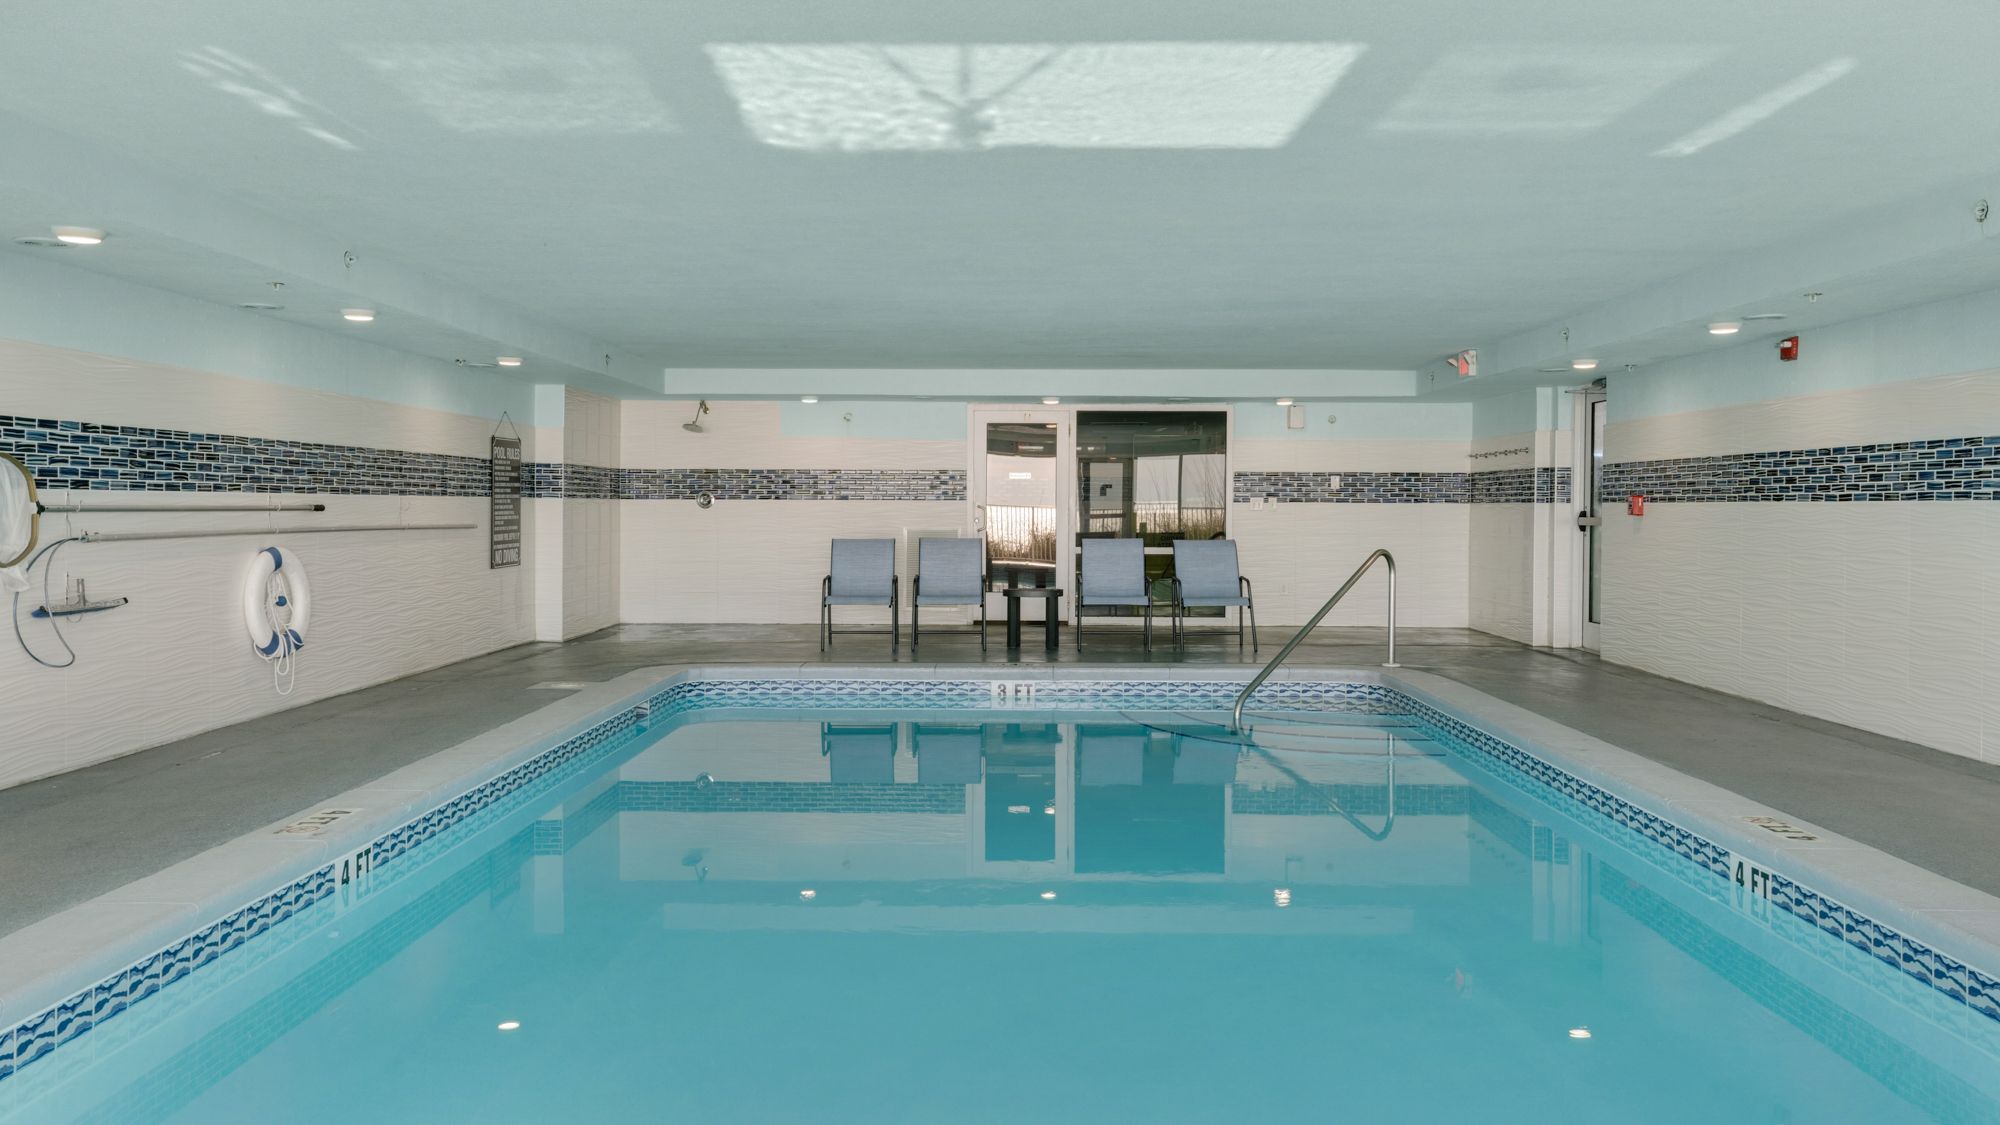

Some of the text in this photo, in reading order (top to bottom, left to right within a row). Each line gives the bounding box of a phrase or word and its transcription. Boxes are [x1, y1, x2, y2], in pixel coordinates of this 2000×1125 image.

[494, 447, 520, 460] POOL RULES
[495, 548, 518, 564] NO DIVING
[1014, 683, 1033, 696] FT
[341, 847, 372, 886] 4 FT
[1736, 861, 1770, 900] 4 FT
